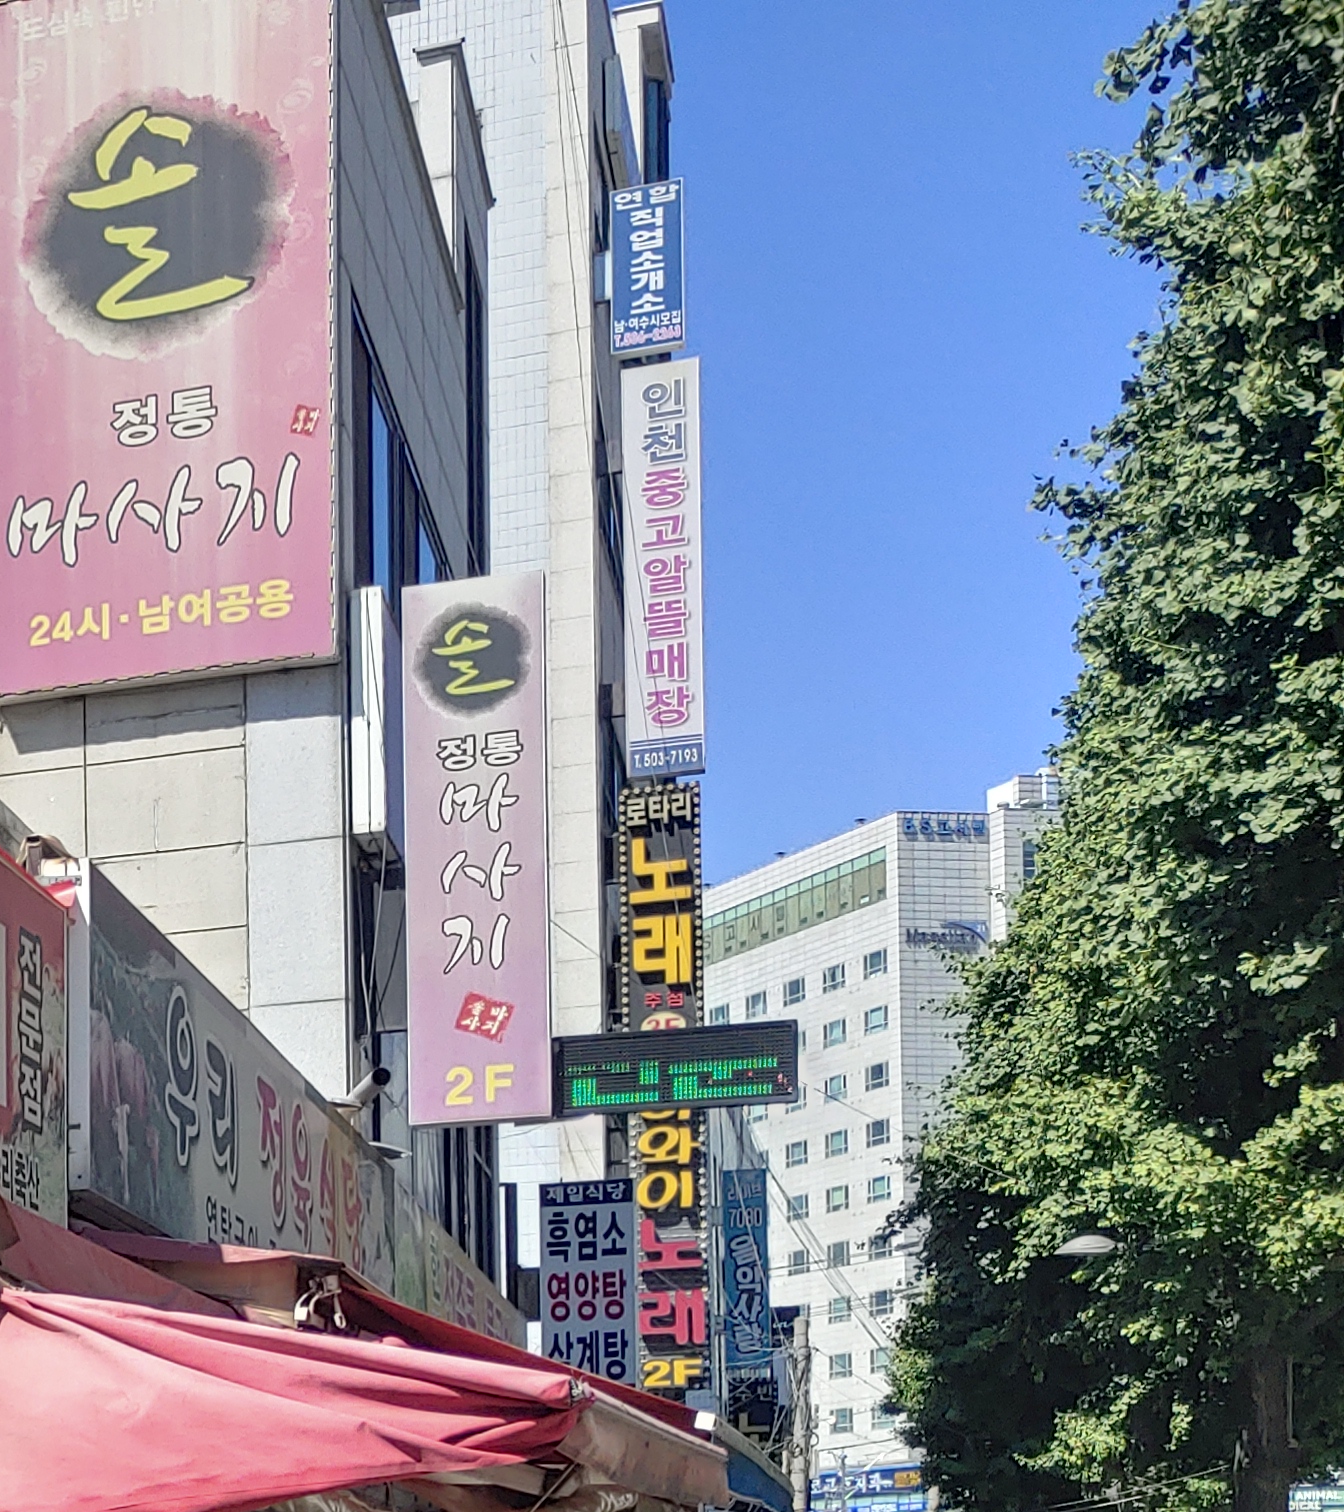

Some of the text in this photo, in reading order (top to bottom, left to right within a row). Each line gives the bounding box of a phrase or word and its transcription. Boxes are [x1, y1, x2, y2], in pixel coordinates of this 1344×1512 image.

[69, 107, 254, 321] 솔
[614, 184, 680, 211] 연합
[629, 206, 666, 315] 직업소개소
[111, 386, 218, 448] 정통
[7, 452, 301, 567] 마사지
[431, 619, 515, 695] 솔
[437, 730, 523, 771] 정통
[625, 792, 693, 828] 로타리
[439, 773, 522, 974] 마사지
[628, 836, 692, 987] 노래
[19, 925, 43, 1134] 전문점
[166, 985, 239, 1188] 우리
[444, 1063, 515, 1106] 2F
[546, 1181, 626, 1204] 제일식당
[636, 1109, 701, 1210] 와이
[546, 1211, 628, 1263] 흑염소
[547, 1268, 627, 1323] 영양탕
[638, 1217, 706, 1345] 노래
[643, 1358, 703, 1387] 2F
[1296, 1490, 1342, 1501] ANIMAL
